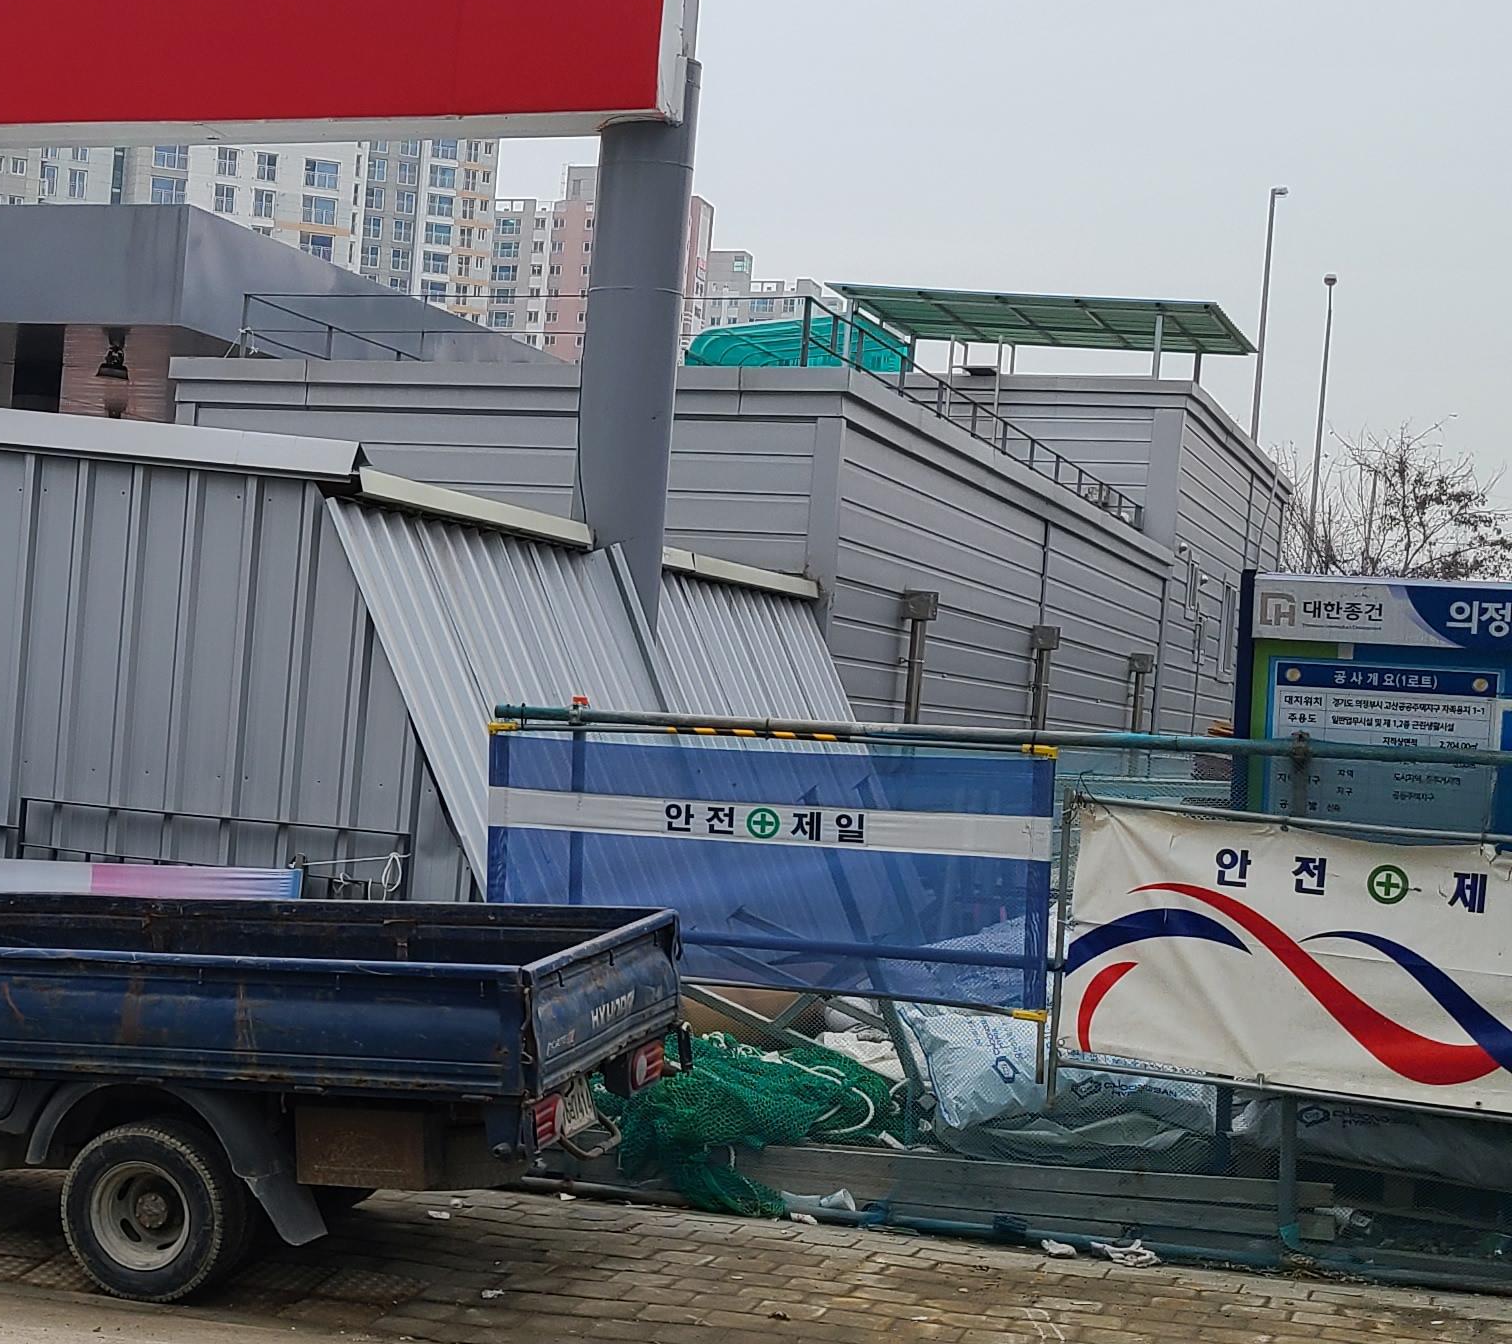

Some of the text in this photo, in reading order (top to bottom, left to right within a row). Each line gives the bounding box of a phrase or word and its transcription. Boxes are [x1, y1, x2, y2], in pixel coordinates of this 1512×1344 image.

[1303, 600, 1383, 622] 대한종건
[1284, 695, 1323, 707] 대지위치
[1288, 712, 1317, 724] 주용도
[665, 803, 865, 843] 안전 제일
[1447, 872, 1488, 914] 제
